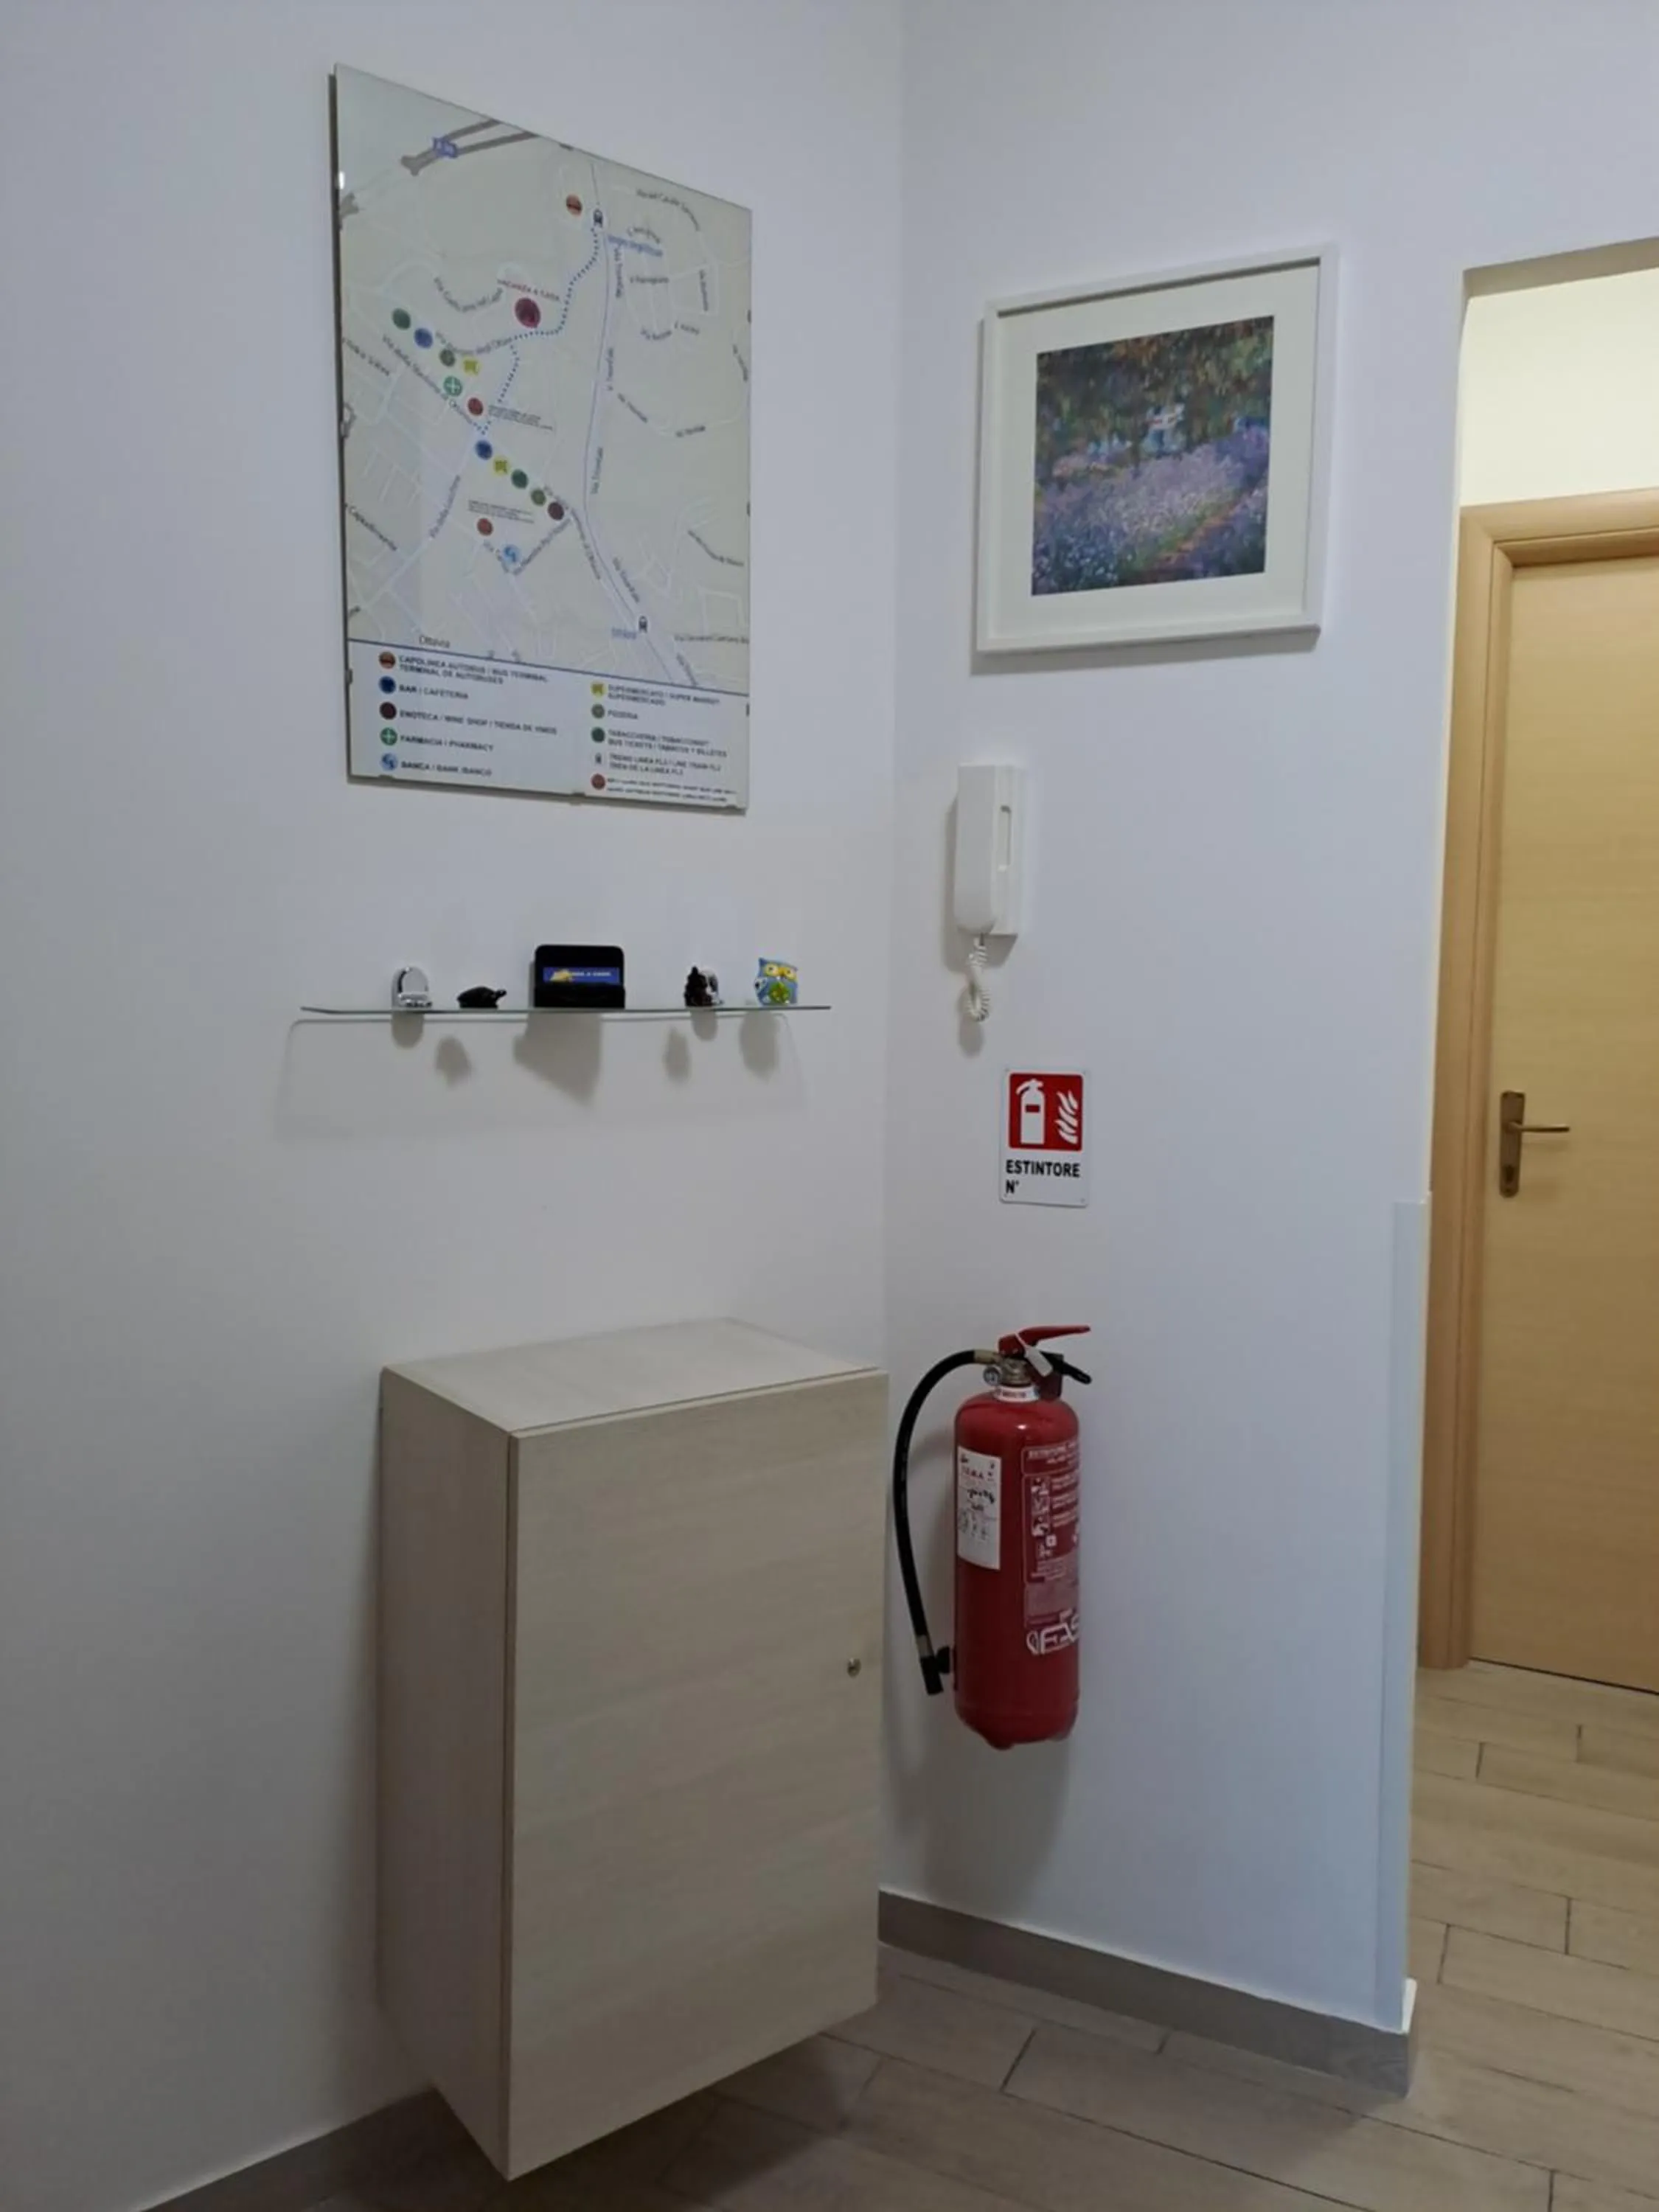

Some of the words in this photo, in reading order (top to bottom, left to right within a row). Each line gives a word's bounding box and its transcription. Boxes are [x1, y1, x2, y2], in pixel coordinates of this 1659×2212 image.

[399, 684, 417, 693] BAR
[400, 709, 438, 720] ENOTECA
[400, 734, 442, 746] FARMACIA
[1006, 1160, 1080, 1178] ESTINTORE
